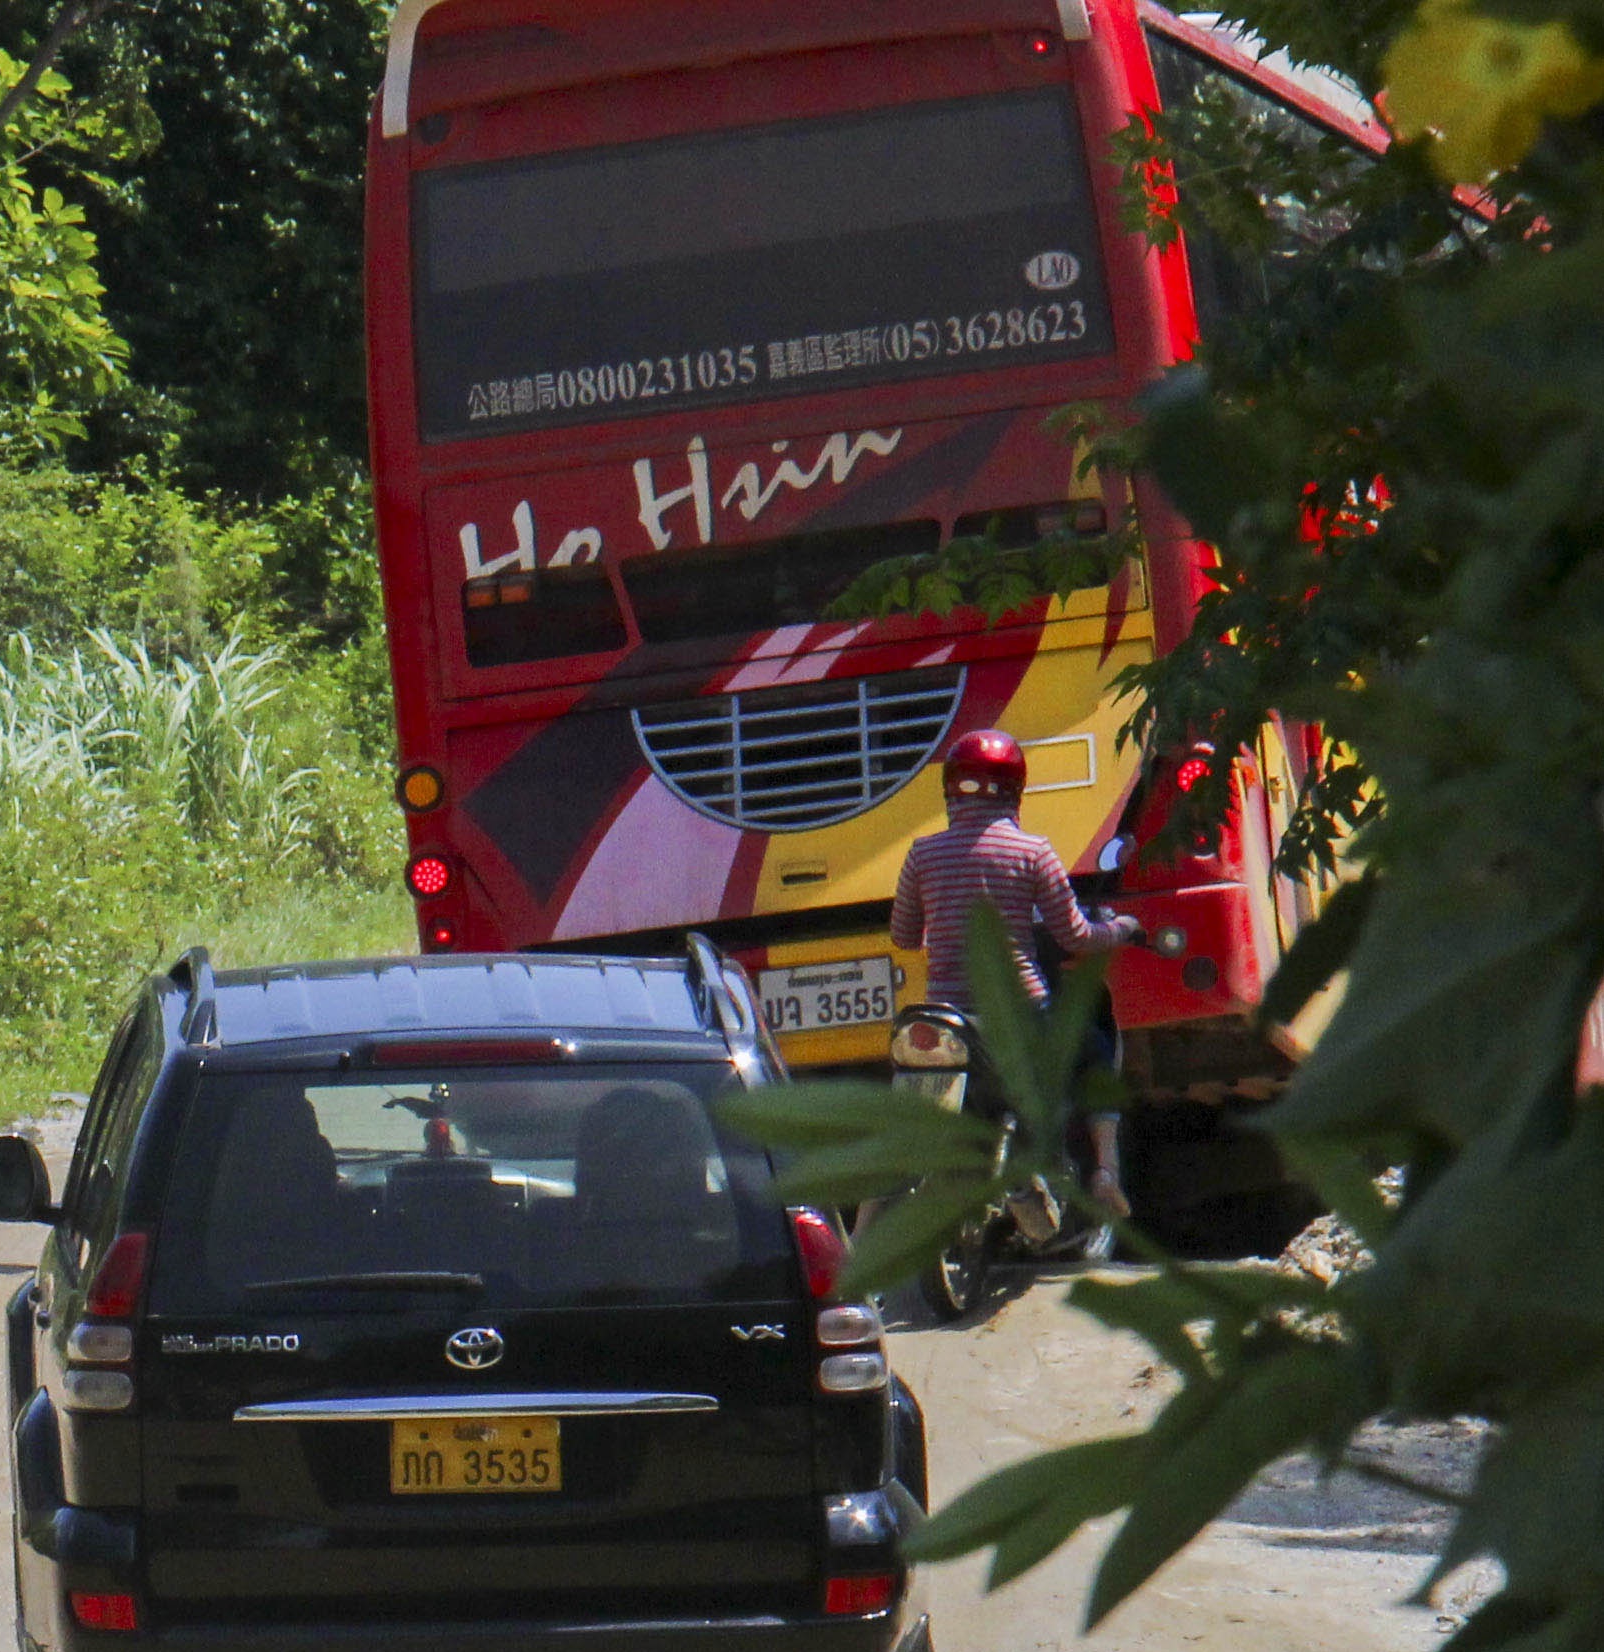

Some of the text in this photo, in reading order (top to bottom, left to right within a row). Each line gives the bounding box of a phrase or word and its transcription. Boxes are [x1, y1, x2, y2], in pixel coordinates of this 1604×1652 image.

[1036, 254, 1073, 283] LAO
[633, 428, 902, 550] Hsin
[817, 986, 888, 1024] 3555
[214, 1334, 300, 1351] PRADO
[730, 1323, 786, 1340] VX
[463, 1449, 551, 1486] 3535
